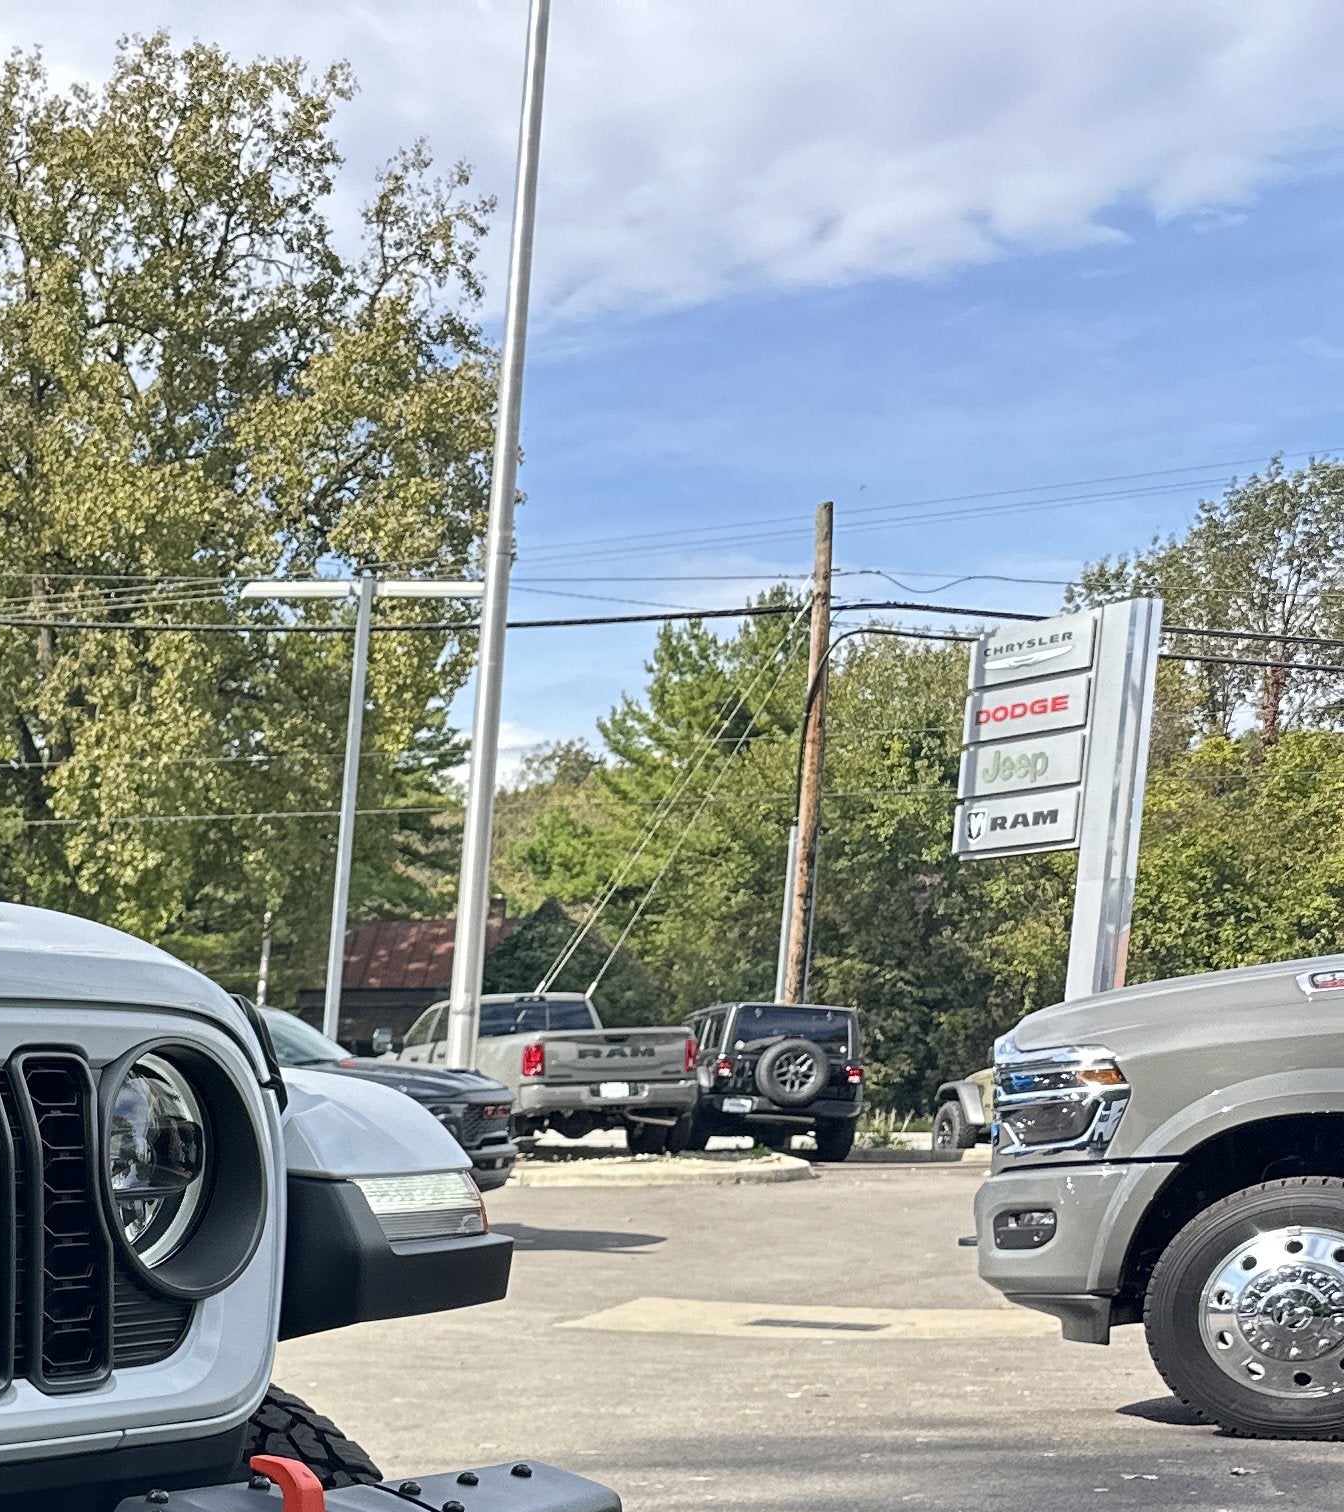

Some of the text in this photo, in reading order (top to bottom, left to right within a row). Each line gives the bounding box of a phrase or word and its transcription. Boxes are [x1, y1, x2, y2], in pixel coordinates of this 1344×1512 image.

[983, 630, 1073, 657] CHRYSLER
[975, 694, 1070, 726] DODGE
[982, 750, 1049, 783] Jeep
[989, 808, 1059, 831] RAM
[577, 1046, 656, 1059] RAM
